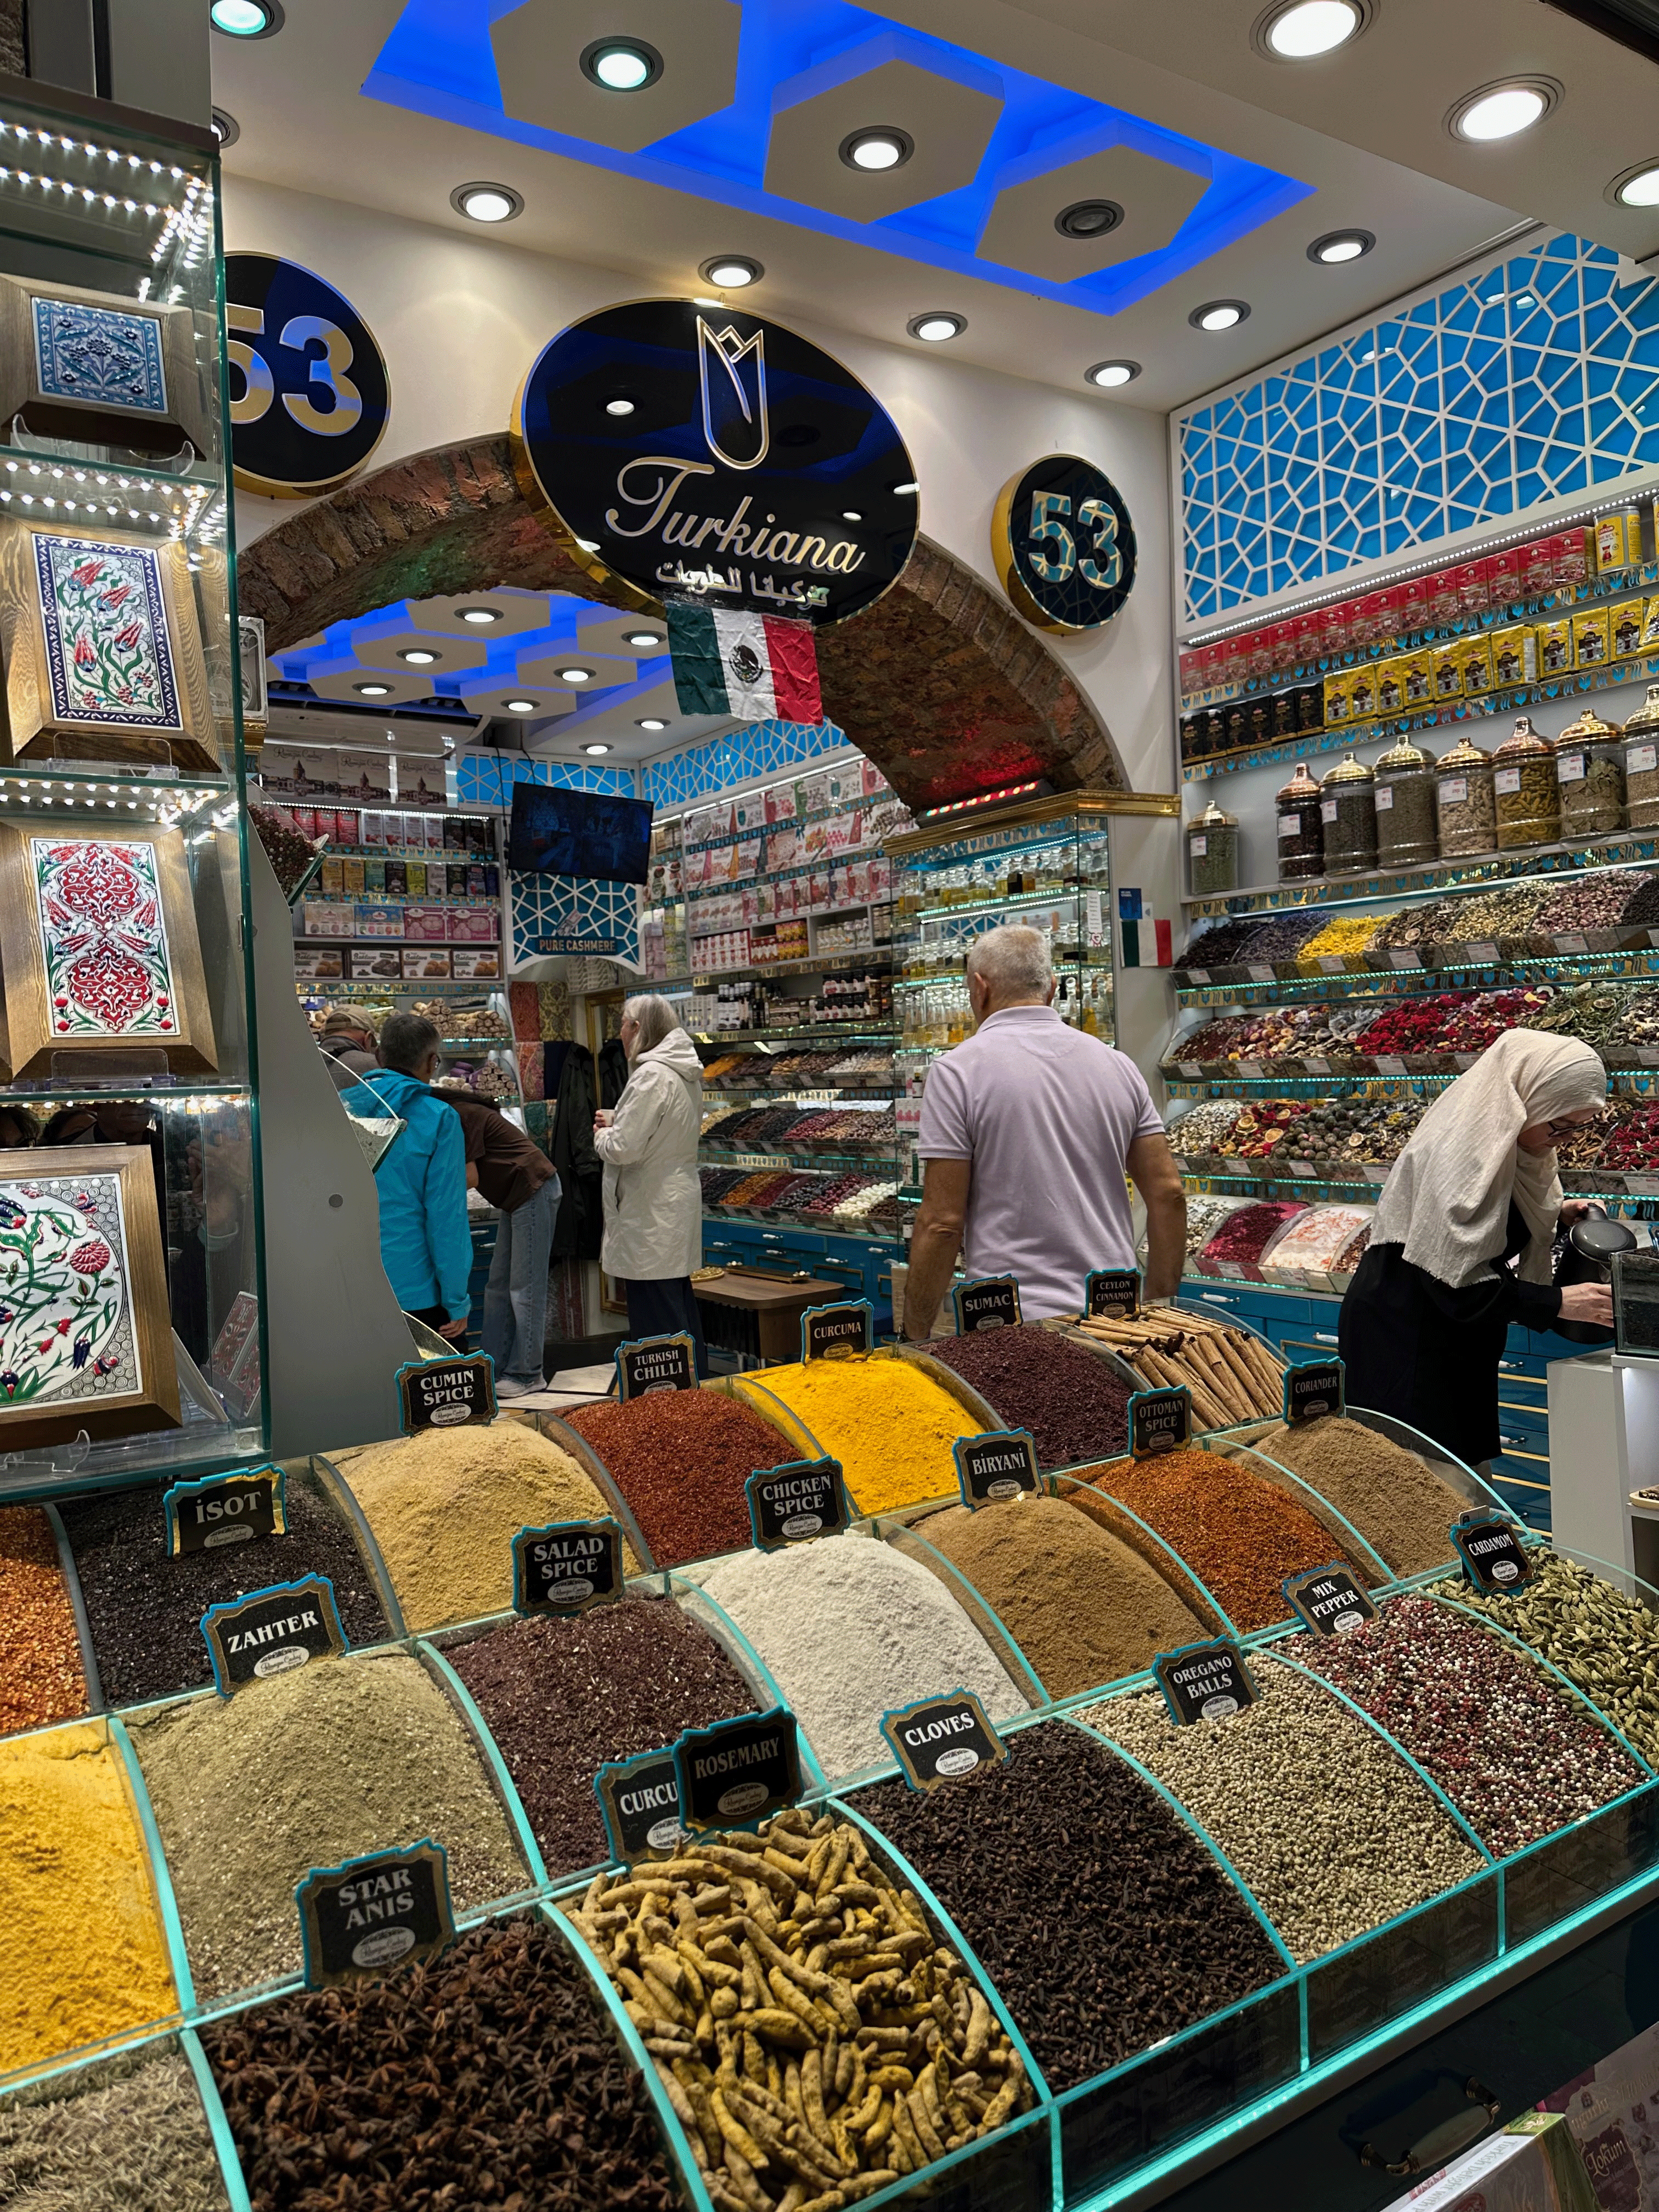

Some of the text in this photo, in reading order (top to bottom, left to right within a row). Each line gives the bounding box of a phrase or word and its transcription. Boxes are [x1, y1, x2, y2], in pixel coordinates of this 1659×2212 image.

[218, 303, 362, 437] 53
[606, 456, 866, 574] Turkiana
[1029, 490, 1124, 590] 53
[539, 939, 616, 952] PURE CASHMERE
[1096, 1291, 1133, 1301] CINNAMON
[1099, 1280, 1131, 1290] CEYLON
[965, 1294, 1011, 1312] SUMAC
[814, 1322, 862, 1339] CURCUMA
[635, 1350, 679, 1365] TURKISH
[420, 1370, 475, 1390] CUMIN
[634, 1362, 683, 1381] CHILLI
[424, 1385, 475, 1406] SPICE
[1295, 1376, 1338, 1394] CORIANDER
[1139, 1399, 1184, 1419] OTTOMAN
[1145, 1415, 1178, 1432] SPICE
[763, 1475, 832, 1502] CHICKEN
[774, 1494, 825, 1516] SPICE
[534, 1538, 604, 1562] SALAD
[1468, 1533, 1514, 1556] CARDAMOM
[541, 1558, 598, 1579] SPICE
[1314, 1580, 1338, 1599] MIX
[1310, 1589, 1359, 1618] PEPPER
[227, 1610, 319, 1654] ZAHTER
[1173, 1656, 1233, 1685] OREGANO
[1186, 1673, 1233, 1700] BALLS
[905, 1712, 975, 1746] CLOVES
[694, 1737, 781, 1780] ROSEMARY
[338, 1868, 413, 1907] STAR
[345, 1892, 414, 1930] ANIS
[1585, 2140, 1626, 2178] Lokum
